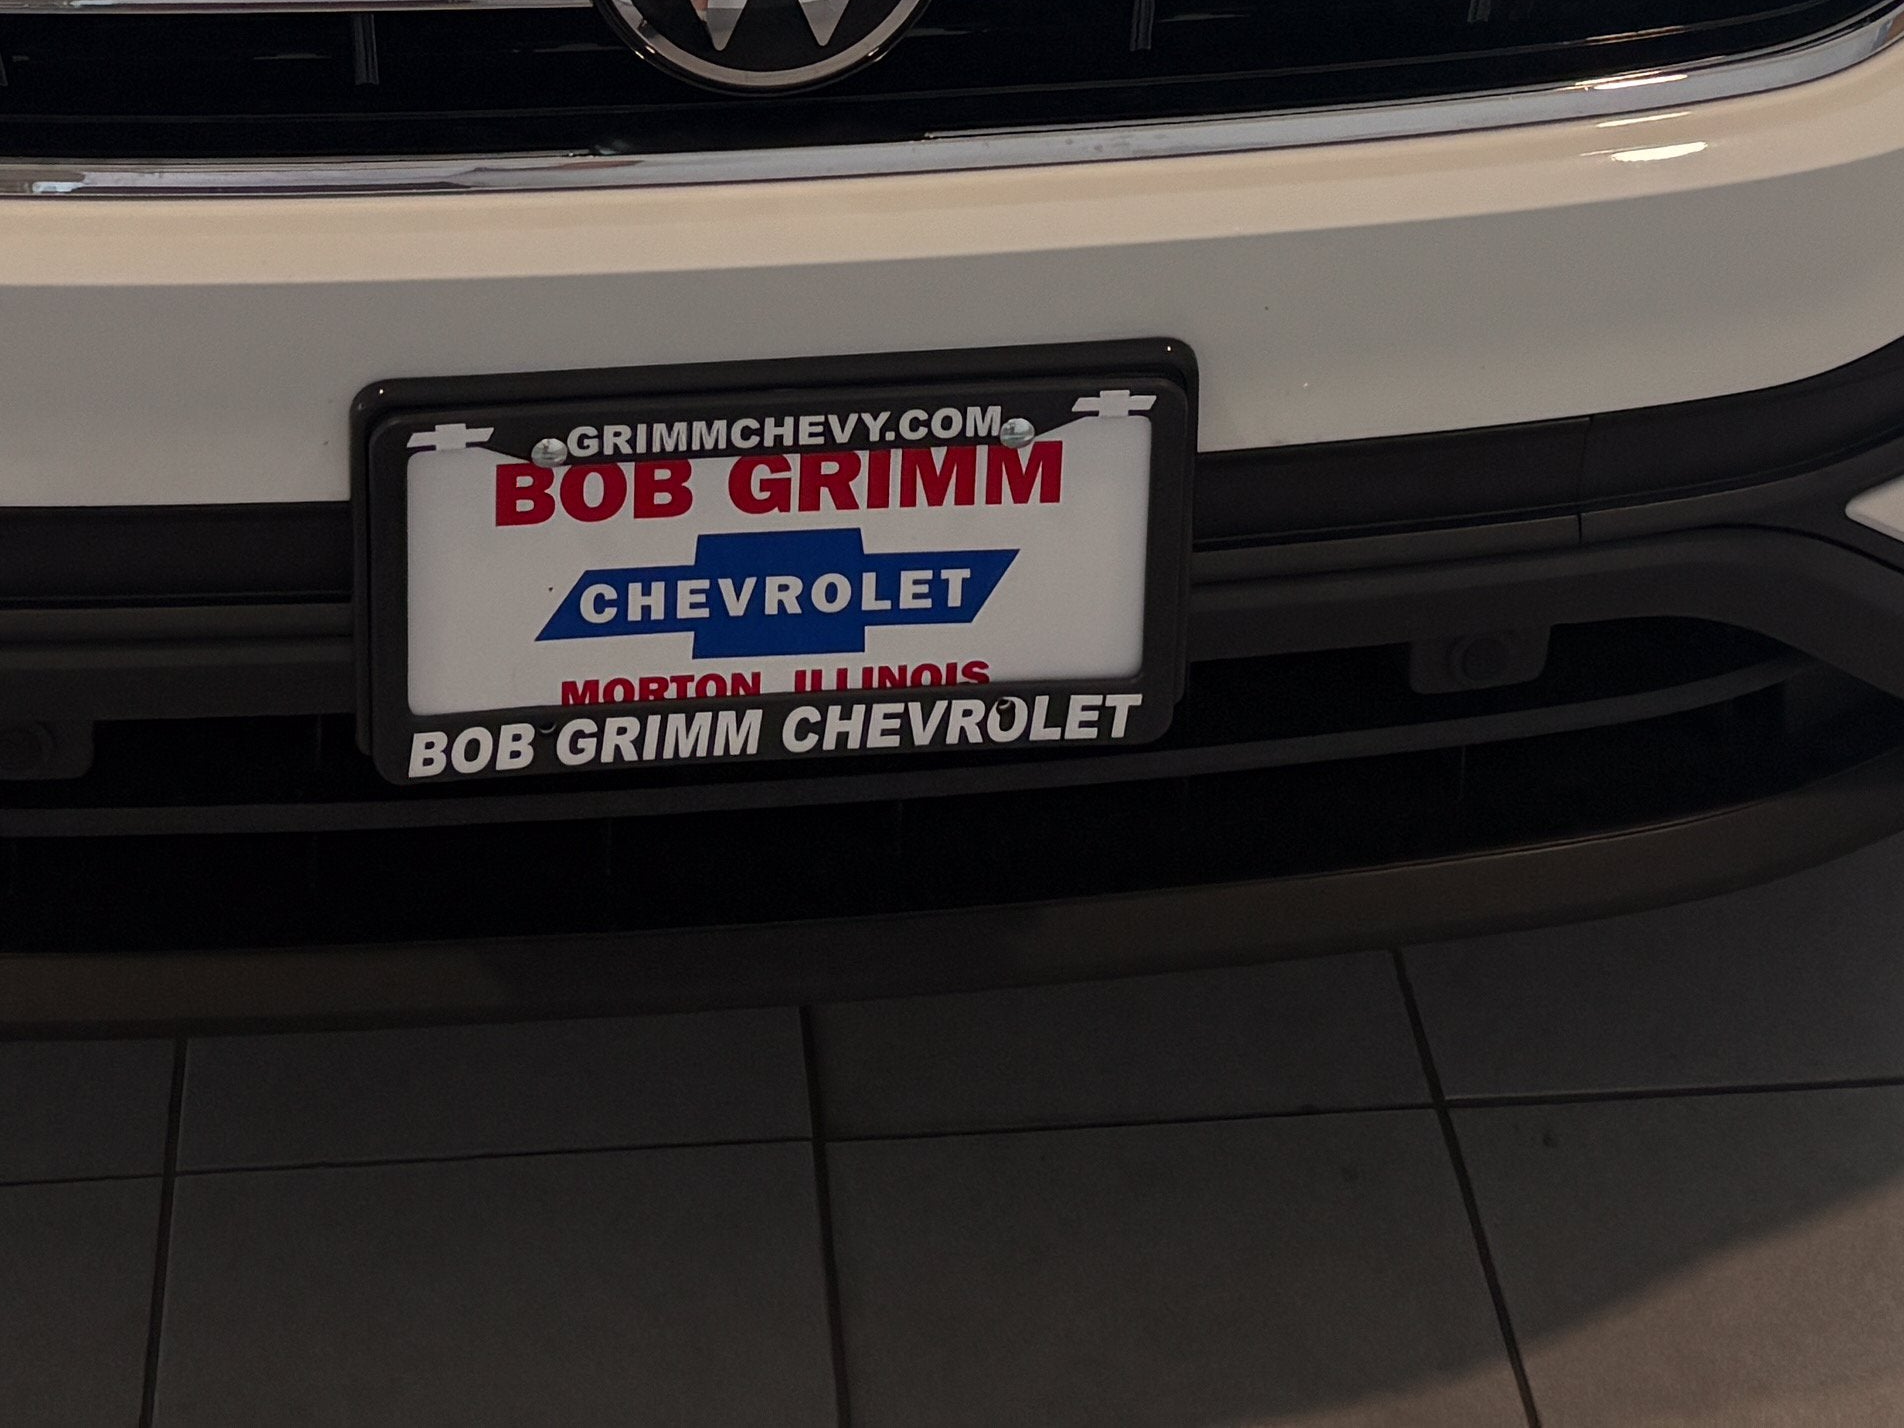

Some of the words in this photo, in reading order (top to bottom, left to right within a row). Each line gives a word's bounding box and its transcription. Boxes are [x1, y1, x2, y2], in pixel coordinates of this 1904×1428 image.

[566, 406, 1003, 457] GRIMMCHEVY.COM
[496, 458, 694, 527] BOB
[728, 440, 1063, 514] GRIMM
[579, 567, 971, 624] CHEVROLET
[561, 671, 762, 706] MORTON
[794, 660, 990, 693] ILLINOIS
[408, 722, 535, 779] BOB
[555, 707, 763, 768] GRIMM
[781, 692, 1144, 754] CHEVROLET
